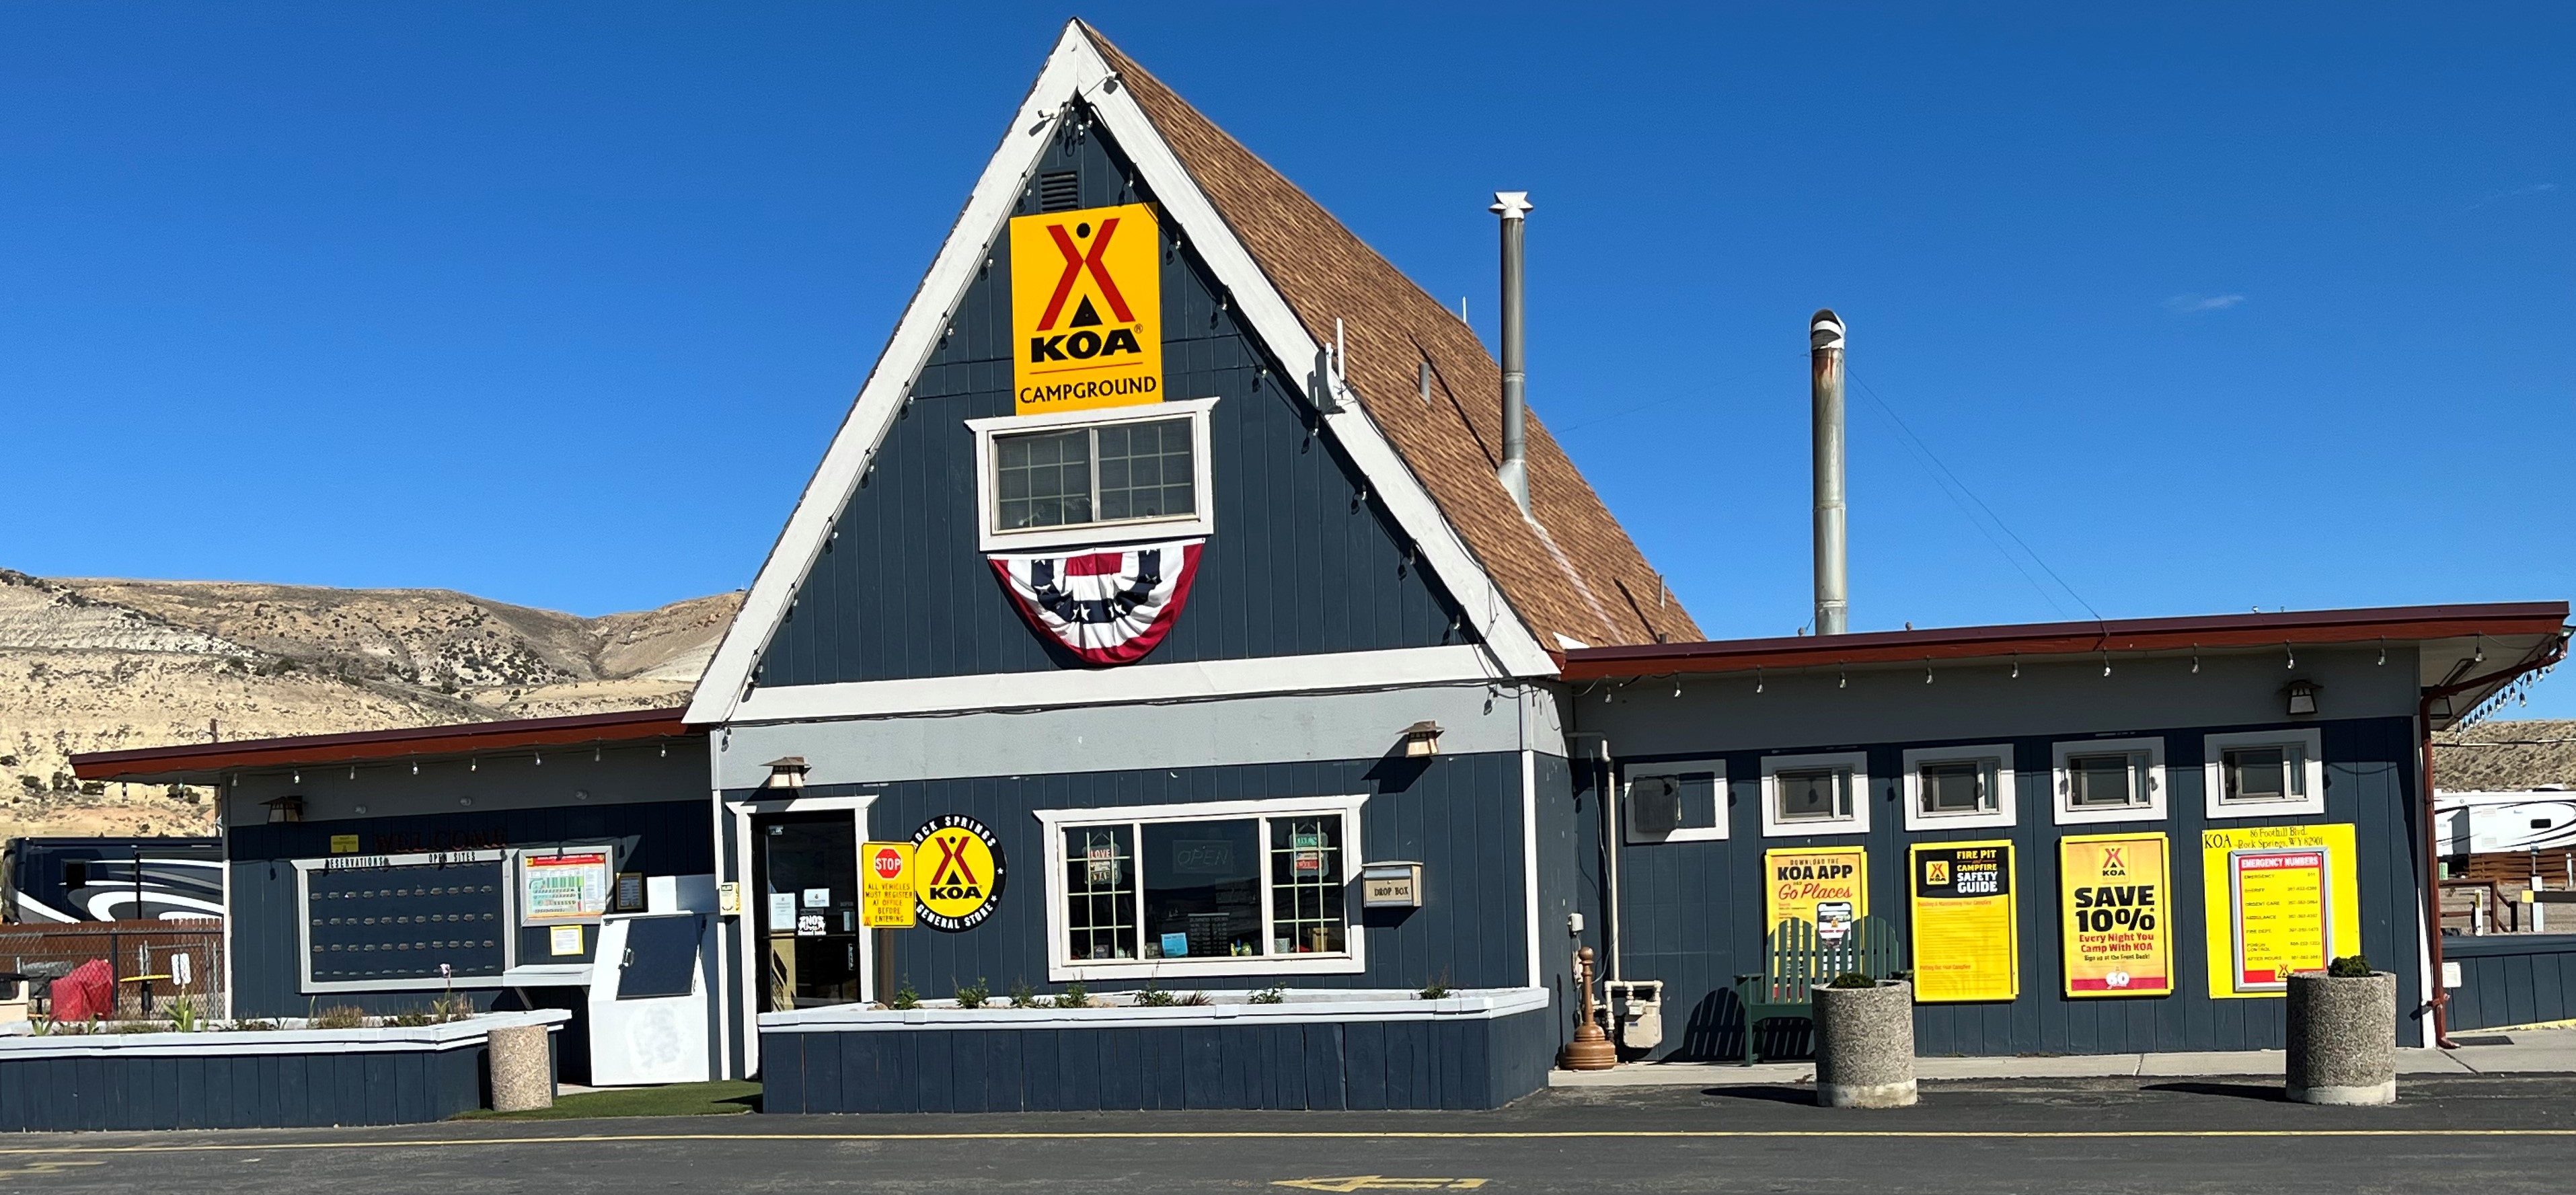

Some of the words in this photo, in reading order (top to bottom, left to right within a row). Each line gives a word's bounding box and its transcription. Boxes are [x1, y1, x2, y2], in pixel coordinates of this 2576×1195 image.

[1031, 329, 1141, 363] KOA
[1020, 376, 1157, 403] CAMPGROUND
[944, 816, 996, 847] SPRINGS
[2259, 828, 2287, 837] Foothill
[2204, 834, 2232, 849] KOA
[2238, 840, 2255, 849] Rock
[2304, 837, 2323, 846] 82901
[428, 853, 447, 863] OPEN
[454, 852, 475, 861] SITES
[1177, 847, 1229, 866] OPEN
[1957, 851, 1978, 859] FIRE
[1980, 850, 1997, 859] PIT
[326, 857, 383, 868] RESERVATIONS
[875, 858, 901, 871] STOP
[1957, 863, 1997, 872] CAMPFIRE
[2241, 858, 2283, 868] EMERGENCY
[2285, 856, 2318, 866] NUMBERS
[1778, 865, 1814, 881] KOA
[1817, 864, 1853, 880] APP
[1957, 872, 1998, 882] SAFETY
[930, 886, 983, 900] KOA
[1374, 888, 1392, 896] DROP
[1395, 886, 1408, 895] BOX
[1778, 884, 1798, 900] Go
[1801, 883, 1852, 899] Places
[1957, 881, 1998, 894] GUIDE
[2074, 885, 2155, 908] SAVE
[916, 904, 960, 929] GENERAL
[964, 902, 993, 927] STORE
[2079, 935, 2106, 943] Every
[2108, 933, 2134, 942] Night
[2136, 932, 2154, 940] You
[2081, 945, 2107, 954] Camp
[2109, 943, 2131, 952] With
